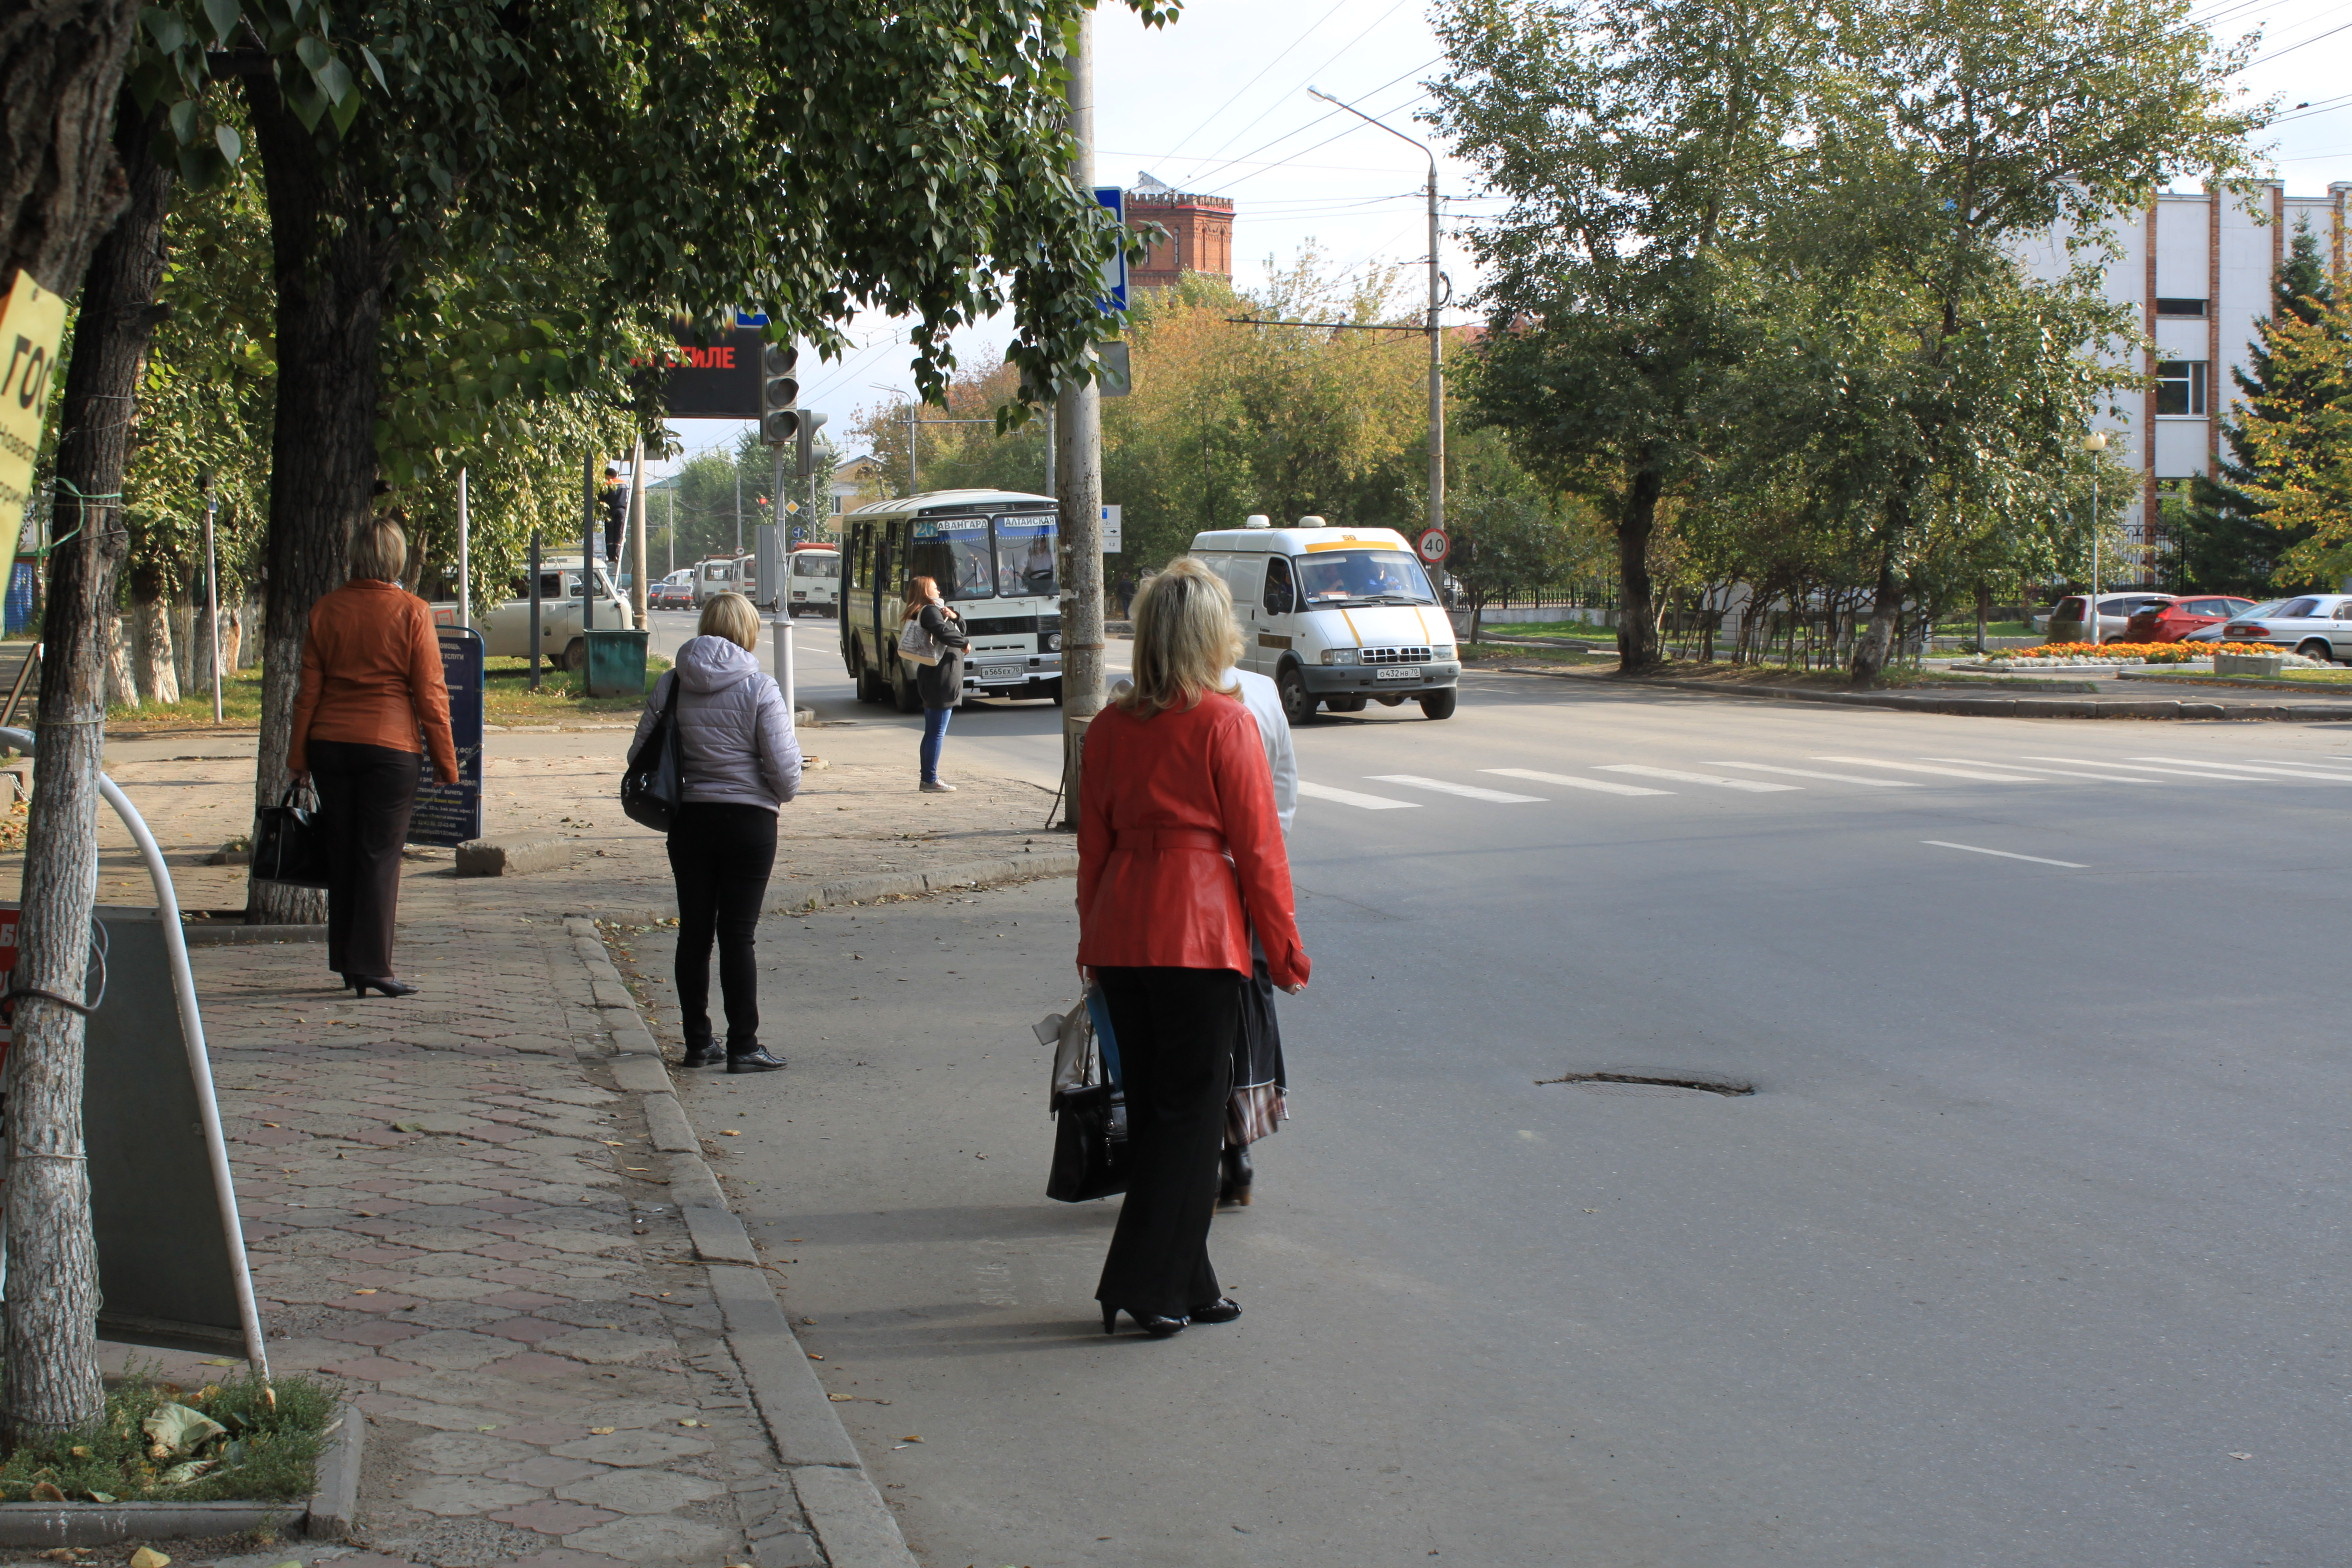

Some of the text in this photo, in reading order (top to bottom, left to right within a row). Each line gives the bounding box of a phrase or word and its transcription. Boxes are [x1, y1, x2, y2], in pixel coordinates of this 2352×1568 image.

[915, 521, 938, 537] 26
[937, 519, 988, 531] АВАНГАРД
[1424, 538, 1444, 553] 40
